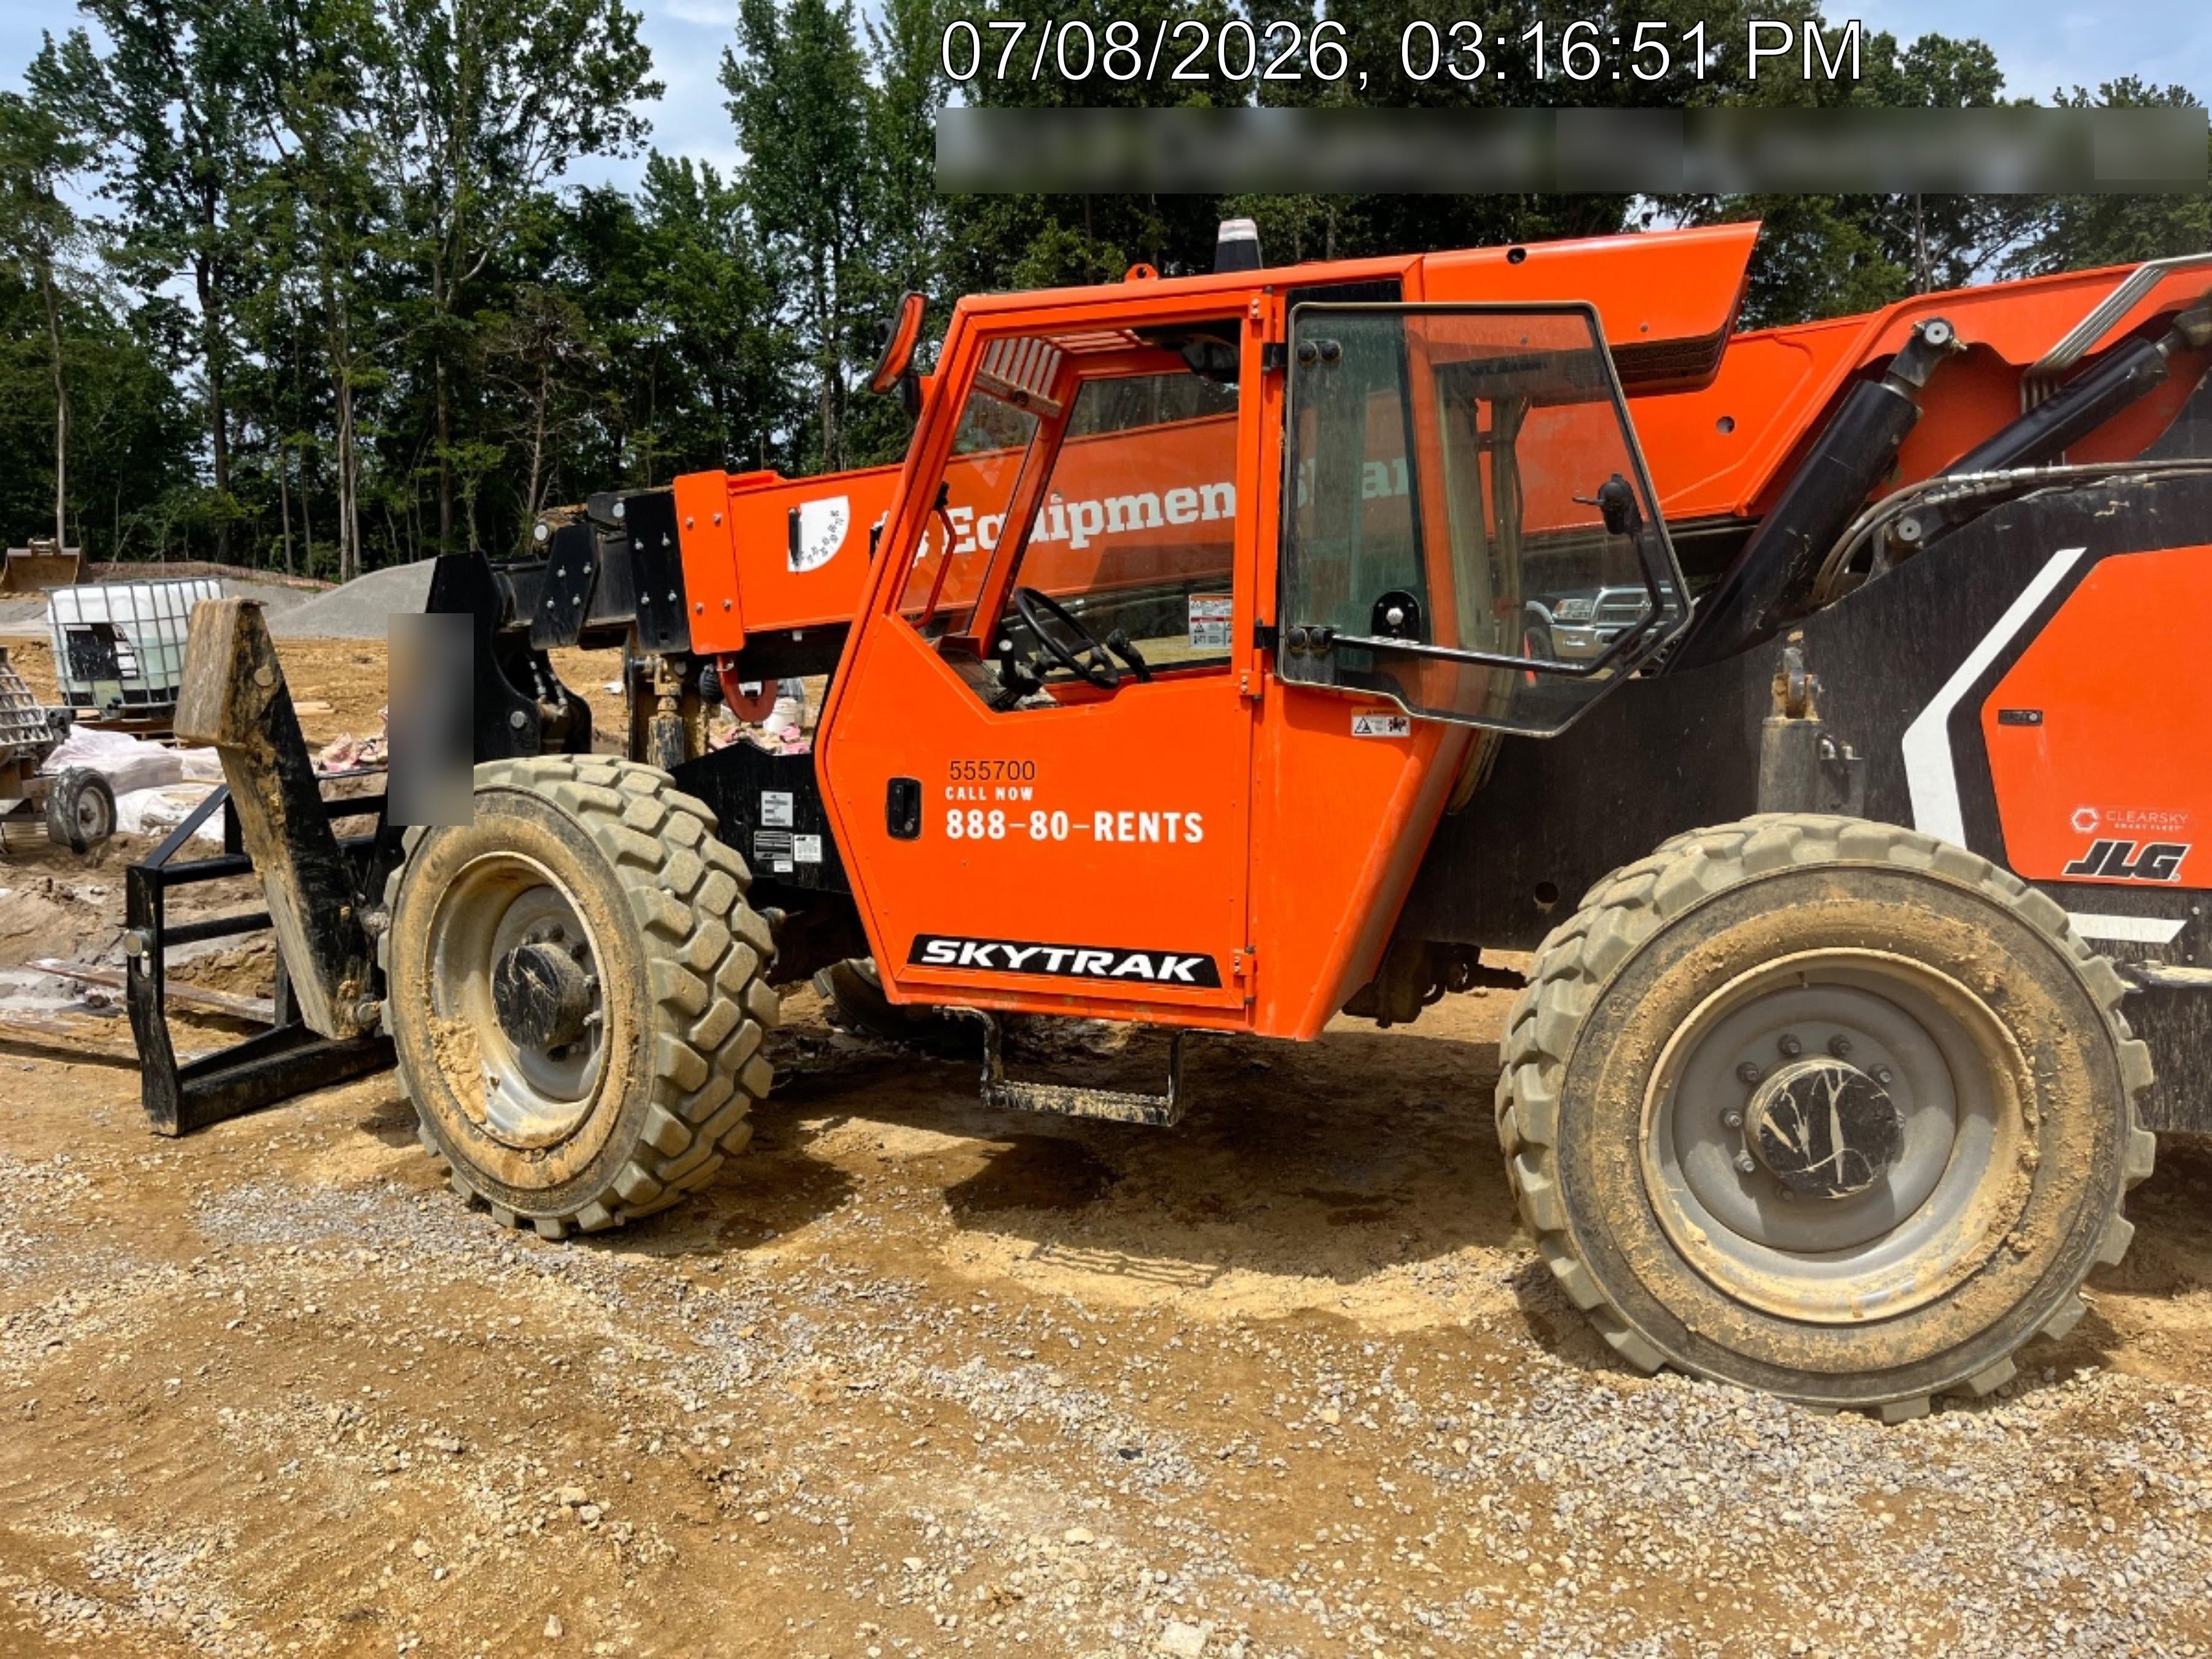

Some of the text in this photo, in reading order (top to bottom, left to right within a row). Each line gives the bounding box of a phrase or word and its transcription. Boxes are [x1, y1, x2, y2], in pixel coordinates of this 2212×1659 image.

[949, 760, 1036, 780] 555700
[945, 786, 1033, 801] CALL NOW
[946, 809, 1204, 843] 888-80-RENTS
[2106, 810, 2189, 825] CLEARSKY
[2061, 838, 2192, 881] JLG
[922, 939, 1205, 982] SKYTRAK
